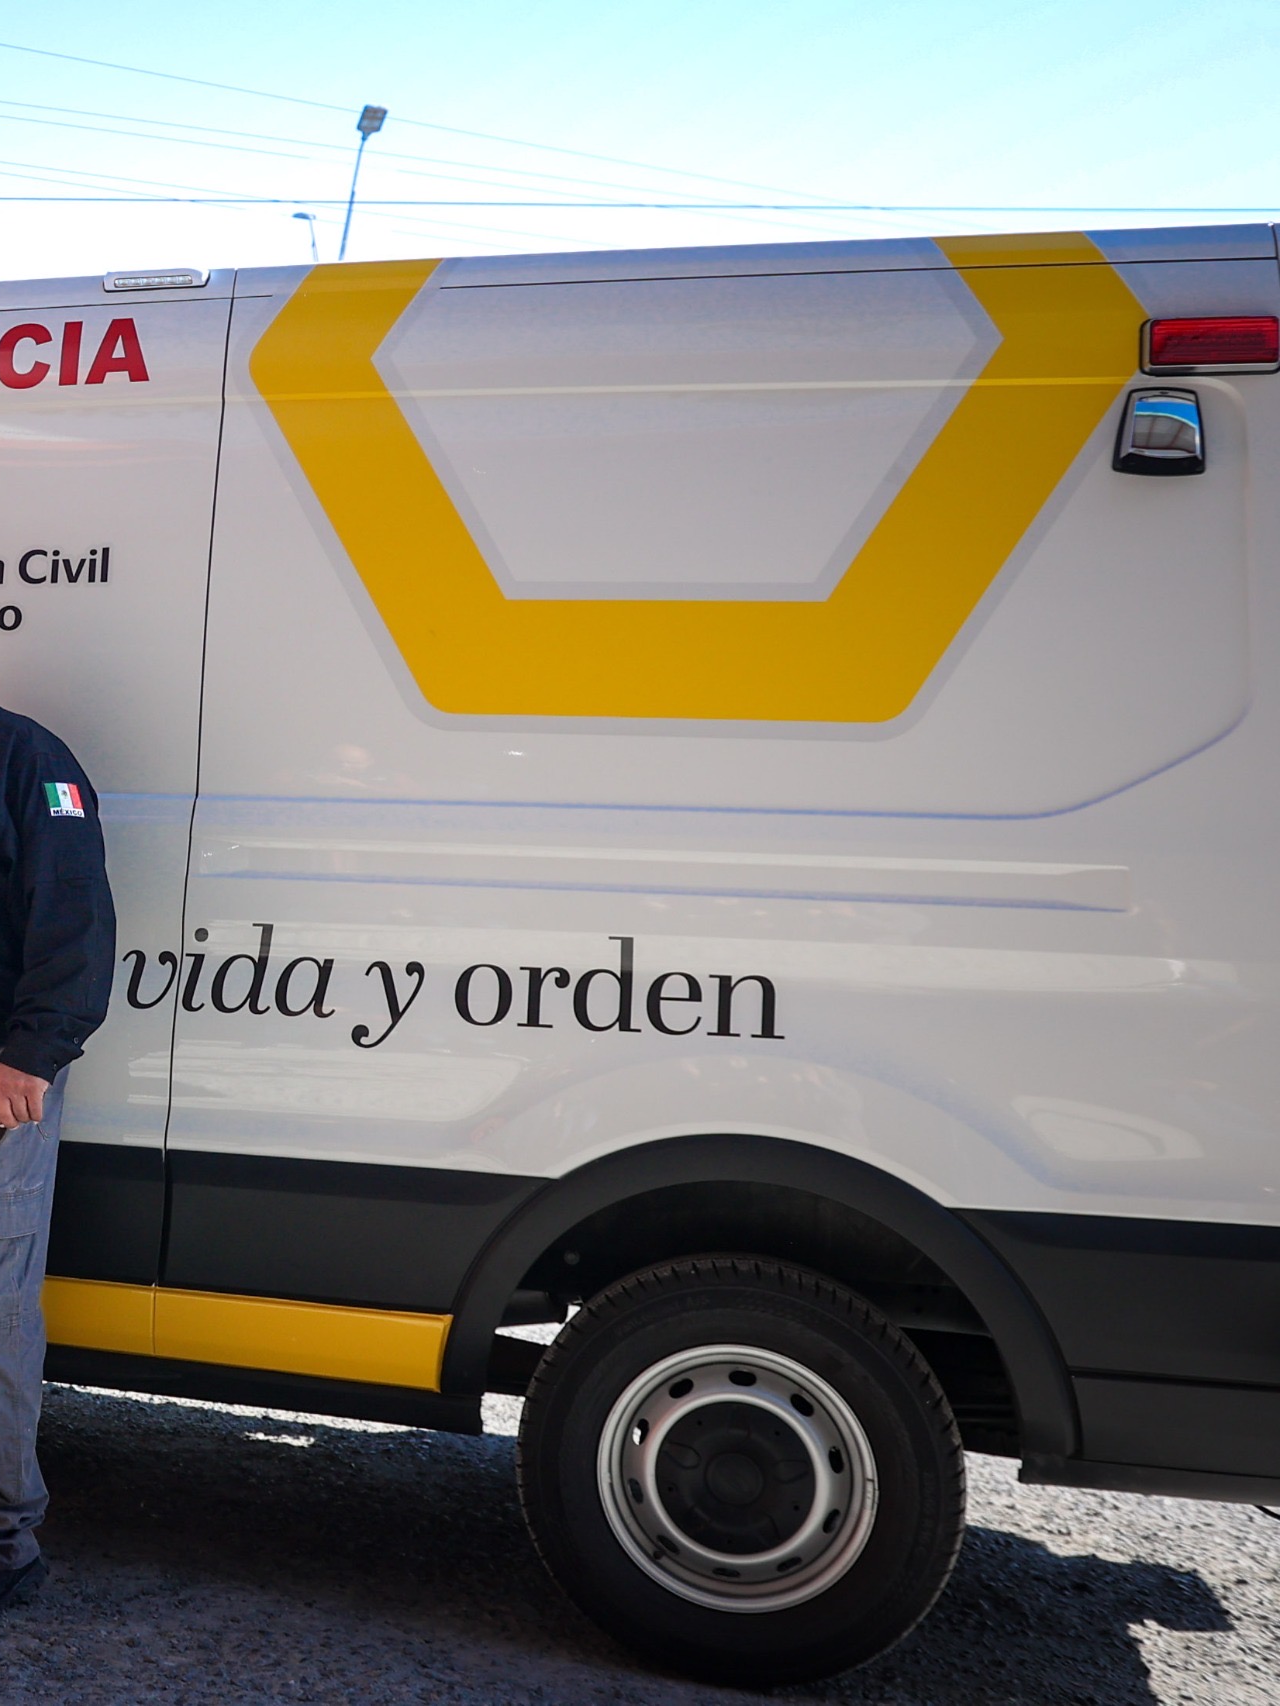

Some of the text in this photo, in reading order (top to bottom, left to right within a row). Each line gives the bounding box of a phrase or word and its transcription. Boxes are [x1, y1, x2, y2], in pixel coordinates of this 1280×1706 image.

[18, 547, 110, 585] Civil
[122, 923, 786, 1048] vida y orden
